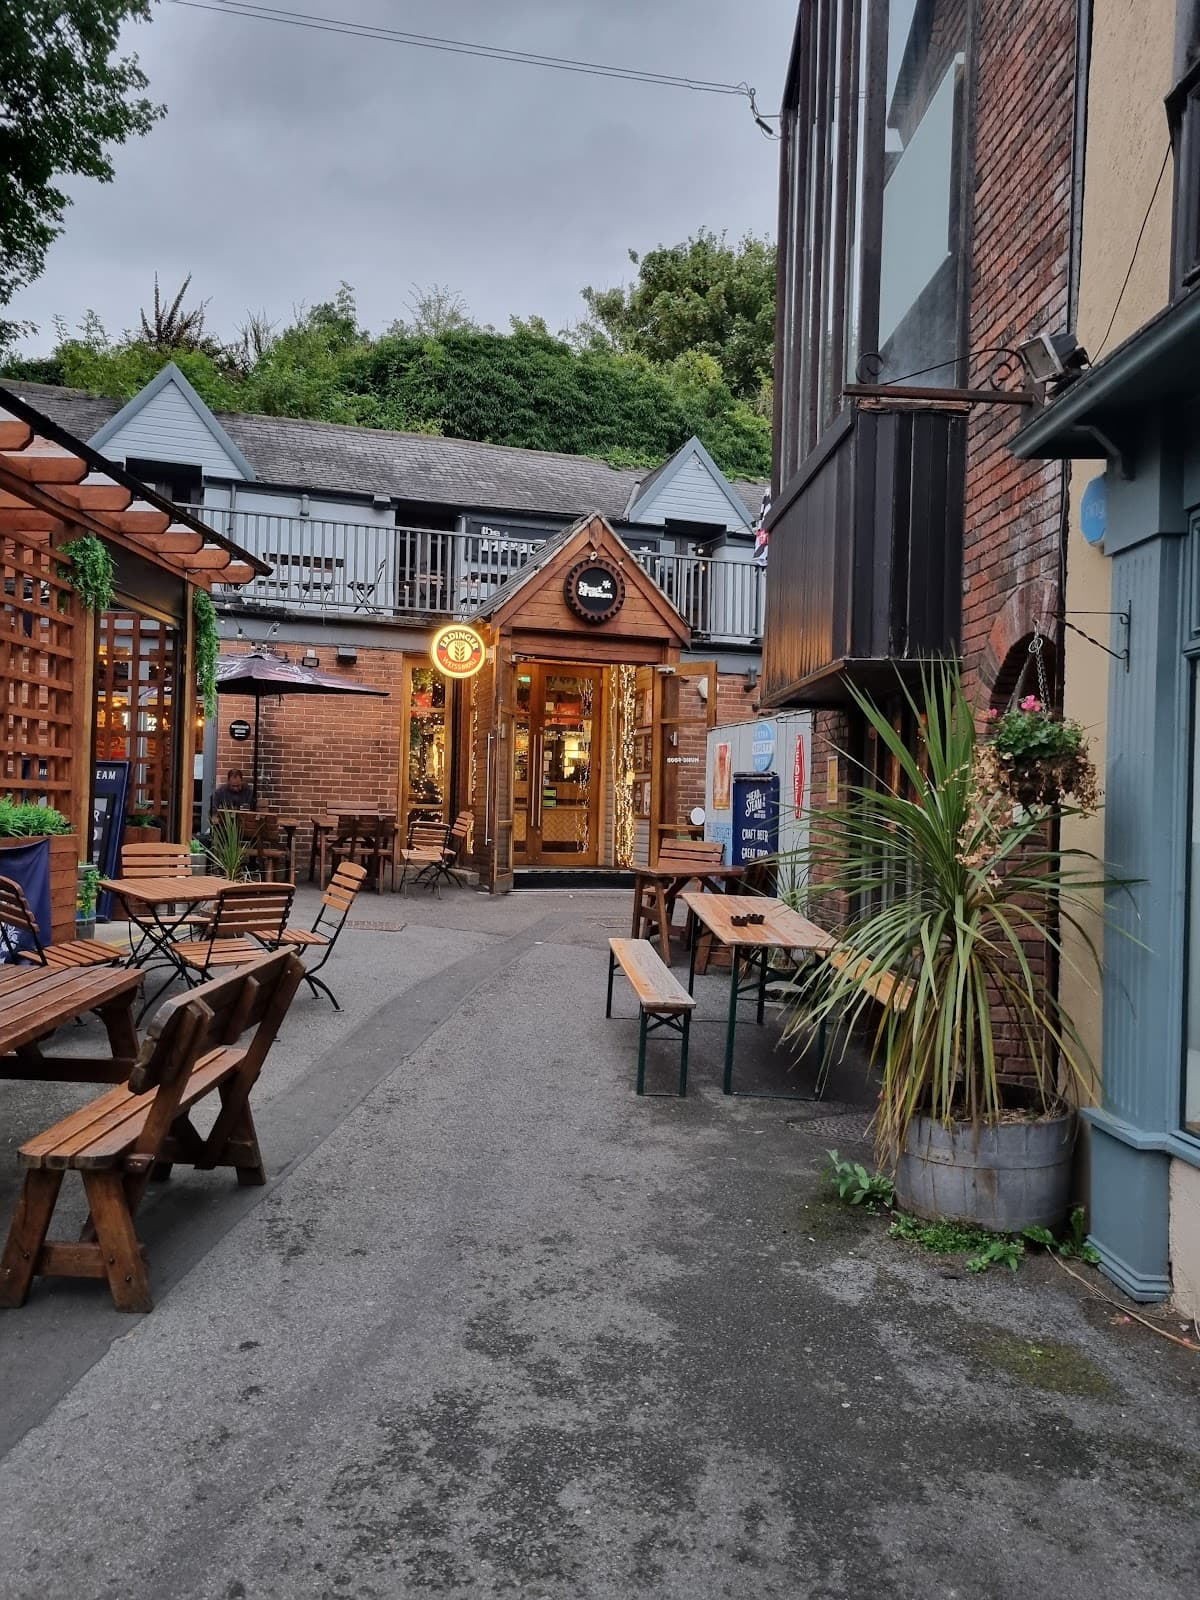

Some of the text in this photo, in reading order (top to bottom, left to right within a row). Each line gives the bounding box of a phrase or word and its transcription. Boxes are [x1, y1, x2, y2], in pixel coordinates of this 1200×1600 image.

[439, 631, 479, 650] ERDINGER
[96, 770, 117, 780] EAM
[741, 828, 756, 841] CRAFT
[741, 847, 755, 859] GREAT
